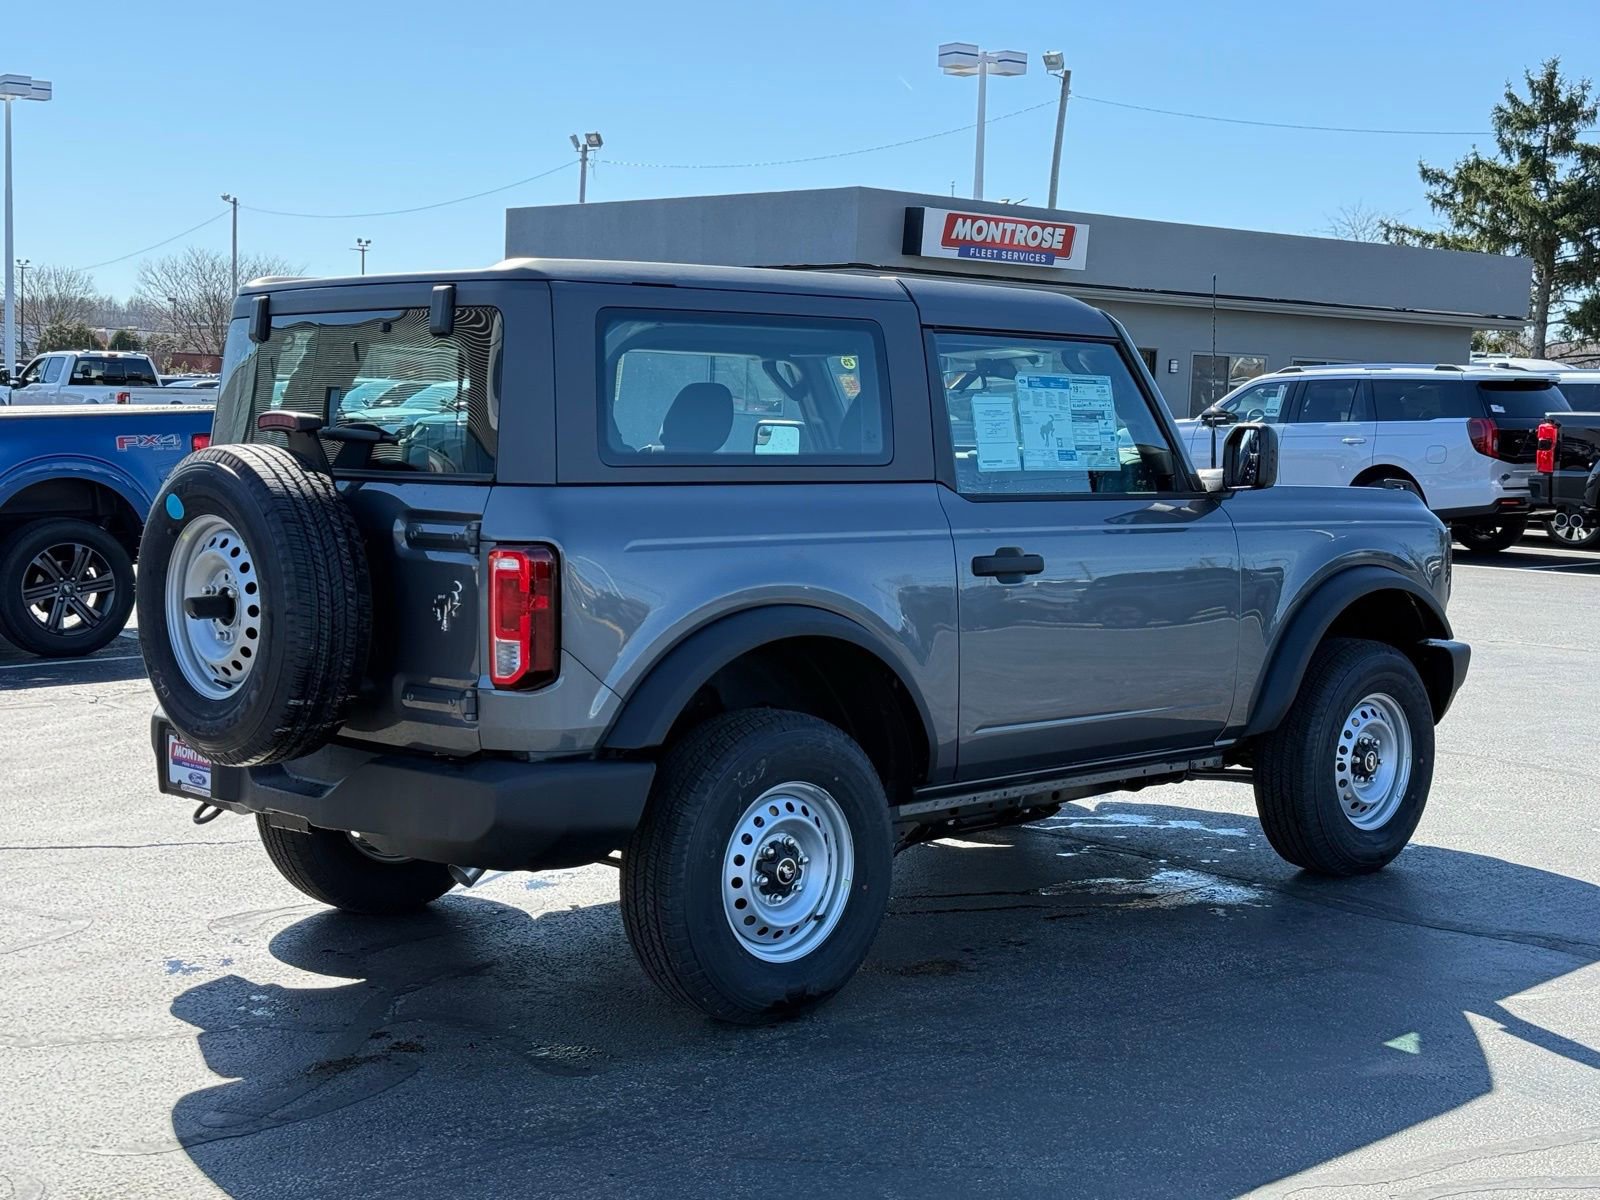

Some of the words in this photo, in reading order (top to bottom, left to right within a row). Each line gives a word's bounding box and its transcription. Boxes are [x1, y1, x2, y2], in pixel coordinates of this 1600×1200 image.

[950, 217, 1067, 250] MONTROSE
[970, 247, 998, 259] FLEET
[1001, 250, 1047, 263] SERVICES
[115, 434, 181, 452] FX4
